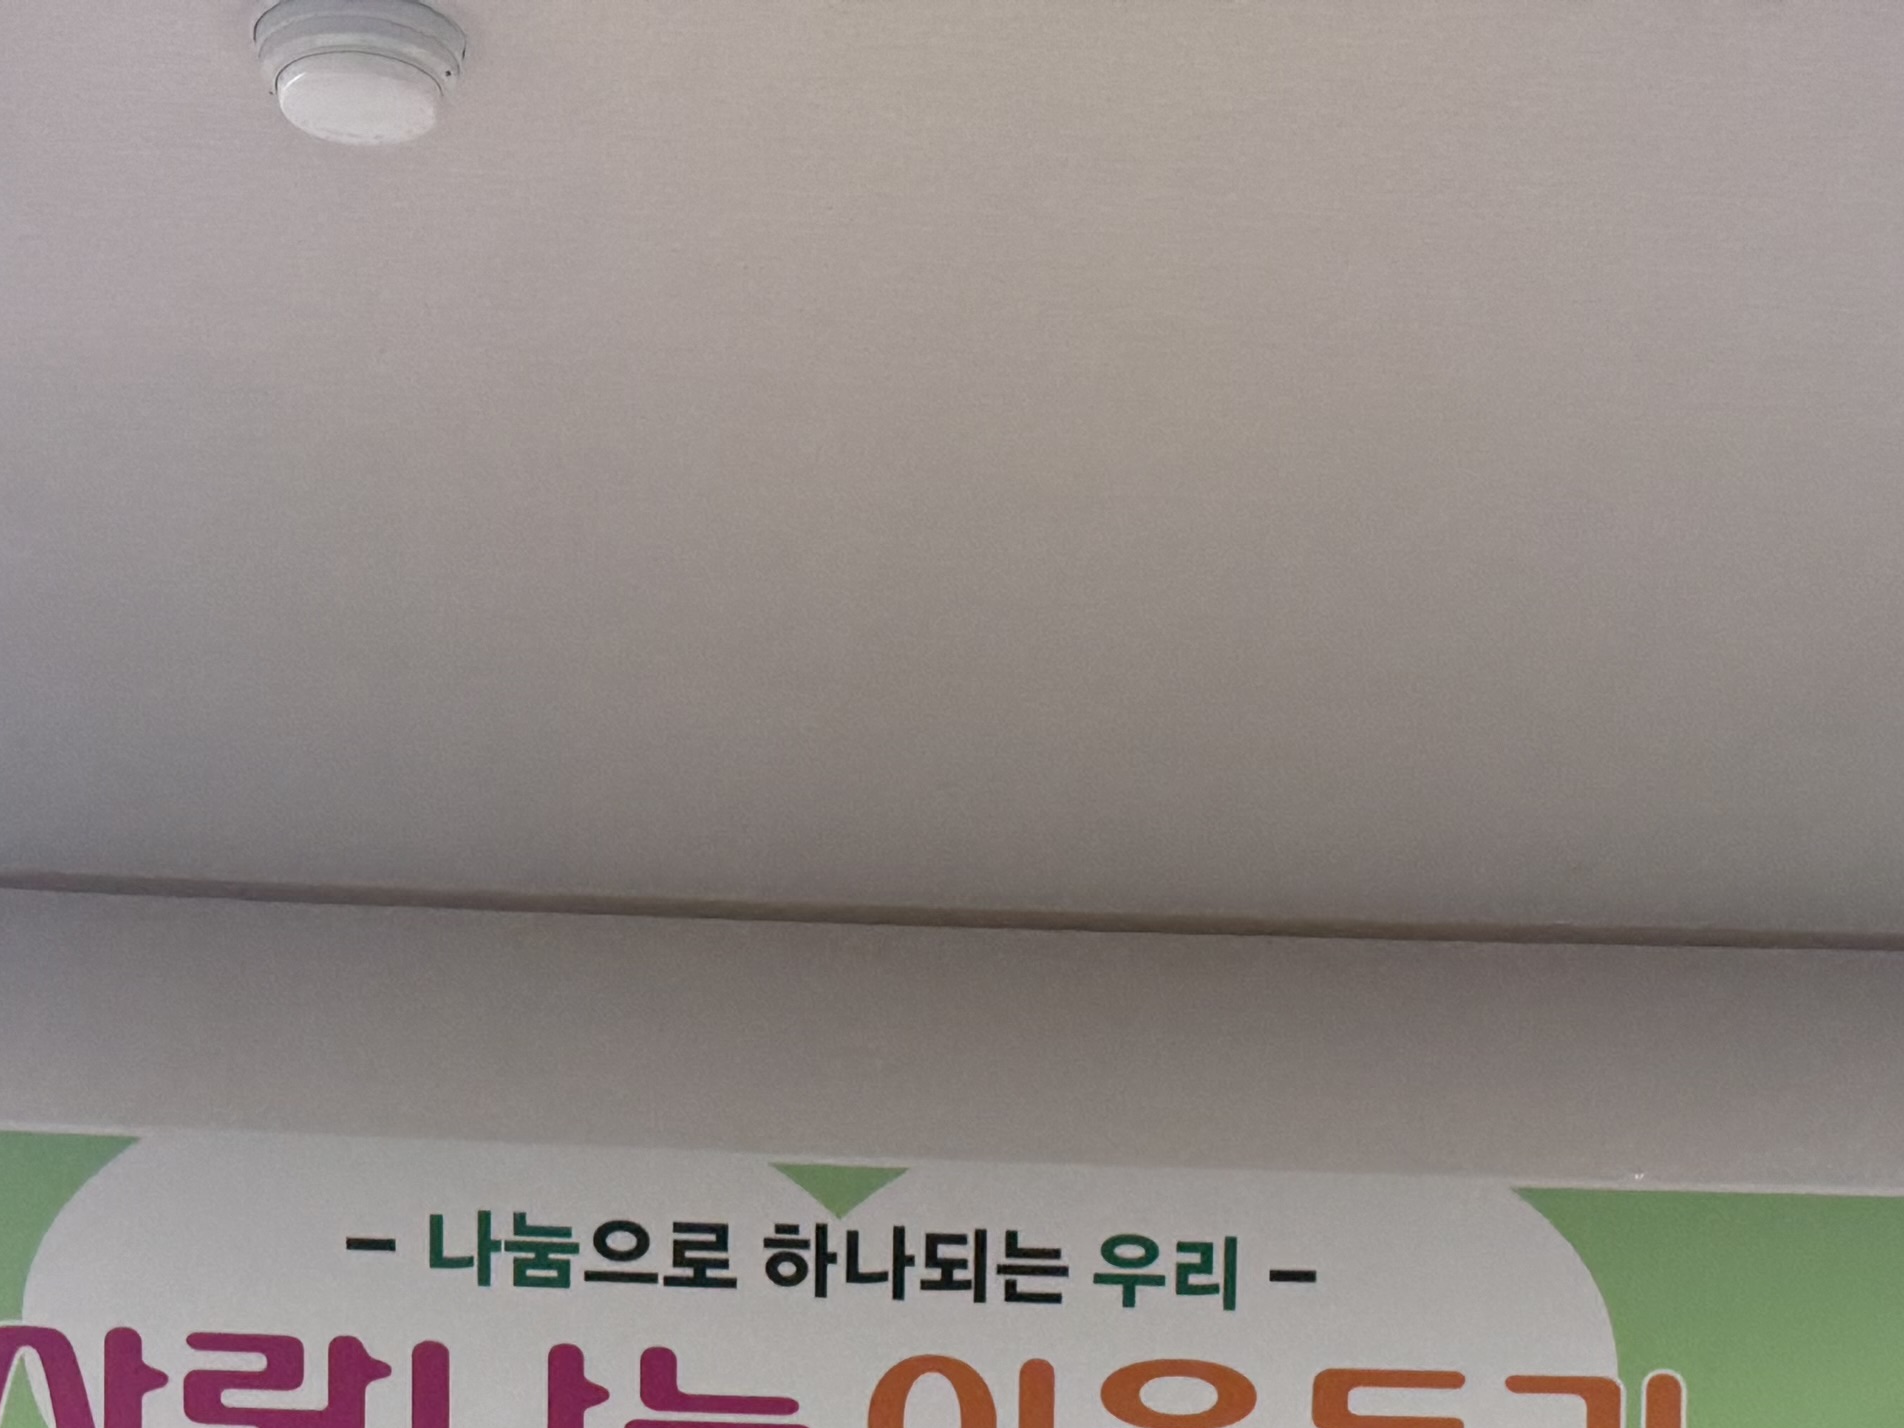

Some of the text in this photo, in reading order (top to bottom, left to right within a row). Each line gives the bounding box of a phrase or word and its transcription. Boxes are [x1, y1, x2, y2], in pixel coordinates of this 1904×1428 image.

[428, 1209, 738, 1289] 나눔으로
[763, 1222, 1069, 1304] 하나되는
[1093, 1233, 1238, 1311] 우리
